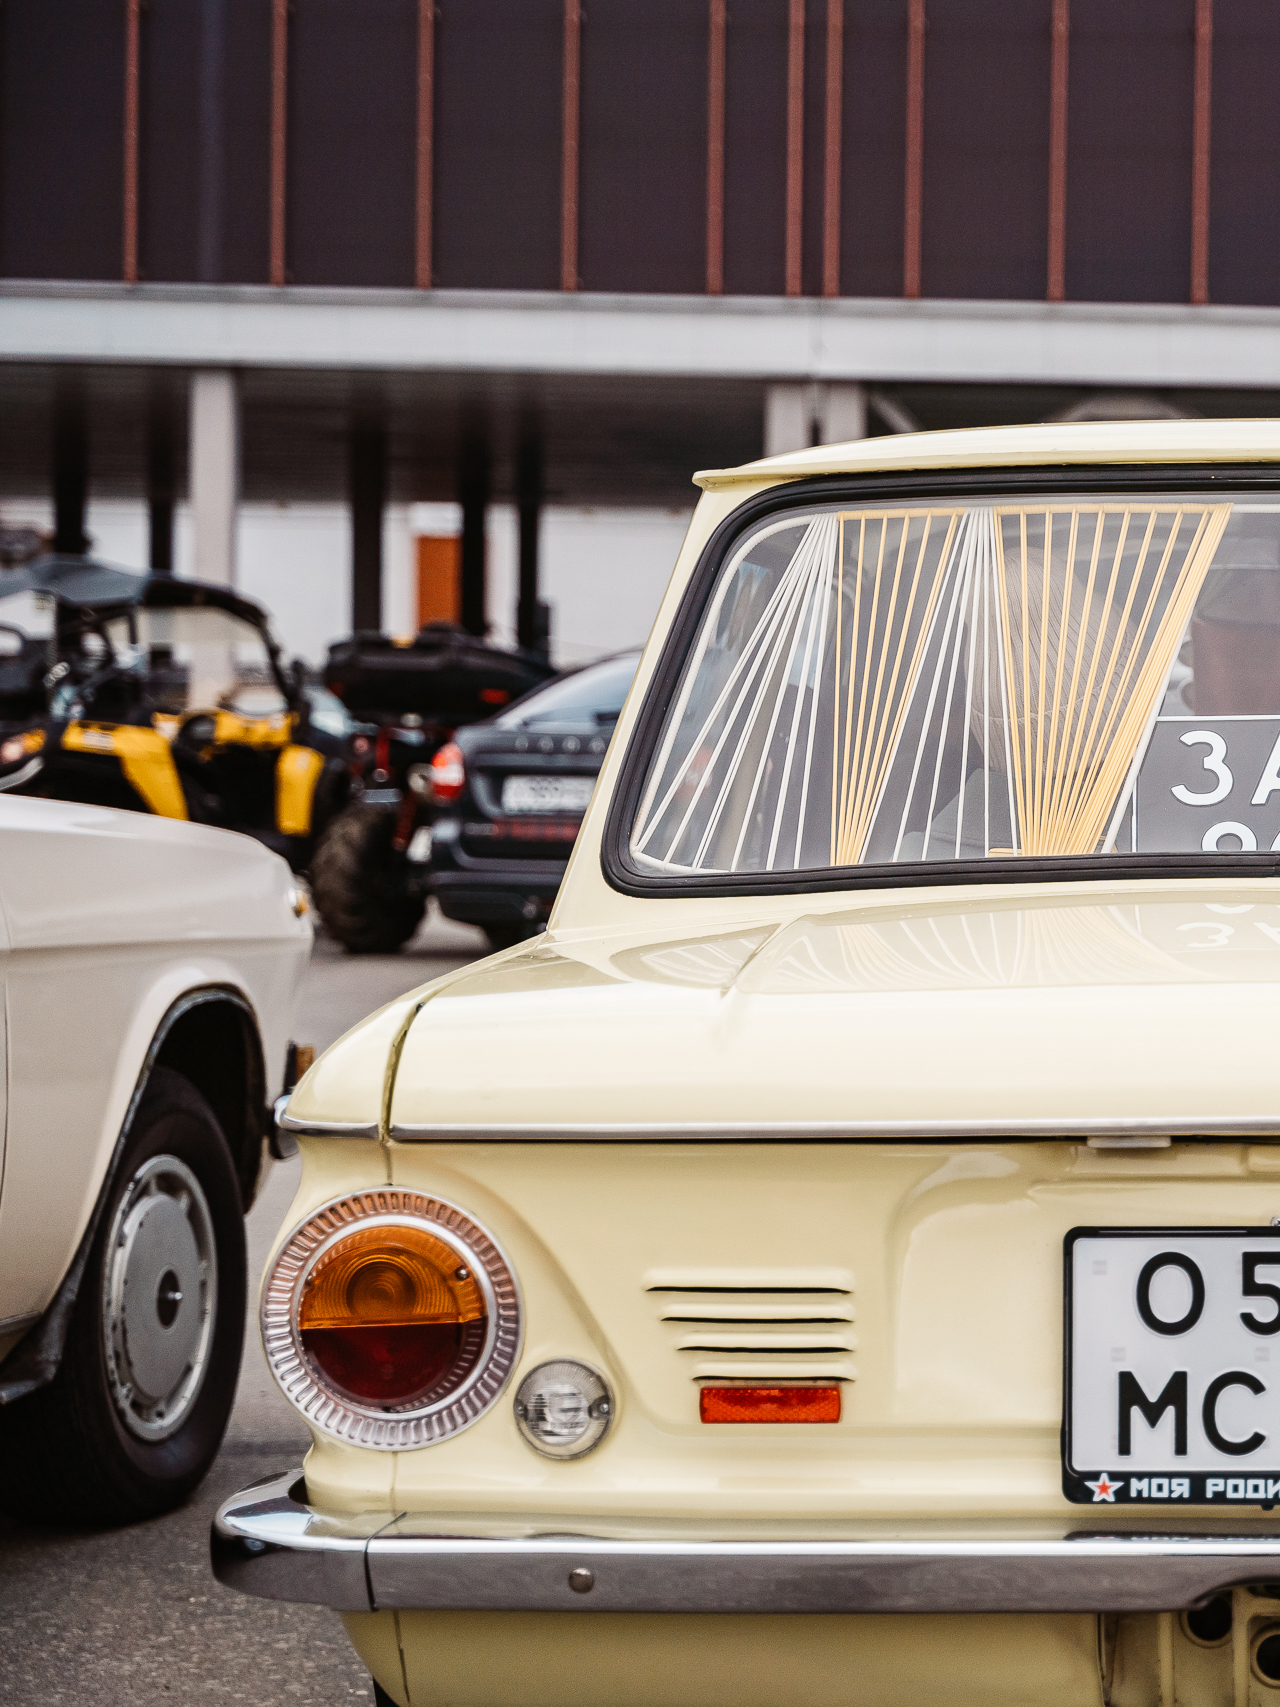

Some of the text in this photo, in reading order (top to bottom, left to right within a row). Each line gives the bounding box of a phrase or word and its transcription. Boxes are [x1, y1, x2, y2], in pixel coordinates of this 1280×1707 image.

[1136, 1251, 1206, 1336] О
[1117, 1370, 1267, 1457] МС
[1130, 1477, 1190, 1499] МОЯ
